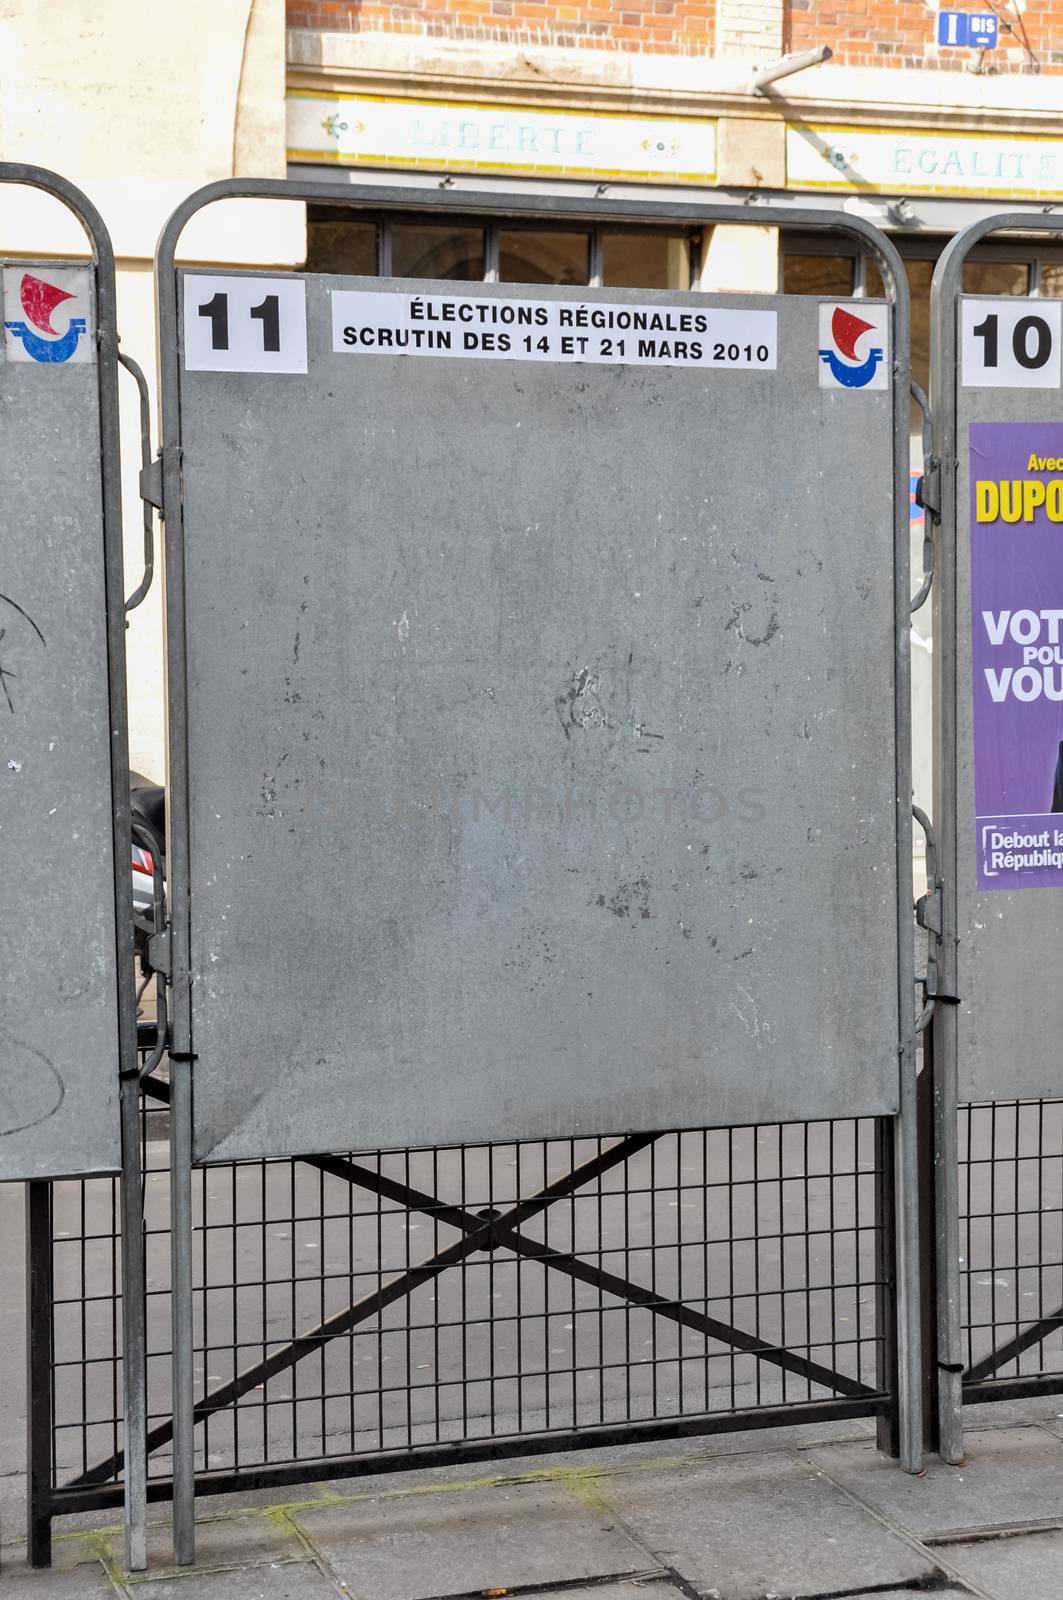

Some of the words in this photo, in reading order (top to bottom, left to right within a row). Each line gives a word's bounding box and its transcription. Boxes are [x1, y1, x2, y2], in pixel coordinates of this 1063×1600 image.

[971, 17, 995, 33] BIS
[198, 292, 281, 352] 11
[410, 297, 549, 326] ÉLECTIONS
[559, 305, 708, 333] RÉGIONALES
[342, 326, 451, 349] SCRUTIN
[463, 332, 511, 351] DES
[523, 335, 550, 353] 14
[561, 336, 589, 355] ET
[599, 338, 626, 357] 21
[638, 339, 703, 360] MARS
[712, 344, 769, 362] 2010
[973, 314, 1053, 370] 10
[1027, 453, 1063, 472] Avec
[976, 480, 1063, 523] DUPO
[982, 609, 1063, 645] VOT
[984, 666, 1063, 703] VOU
[991, 830, 1050, 850] Debout
